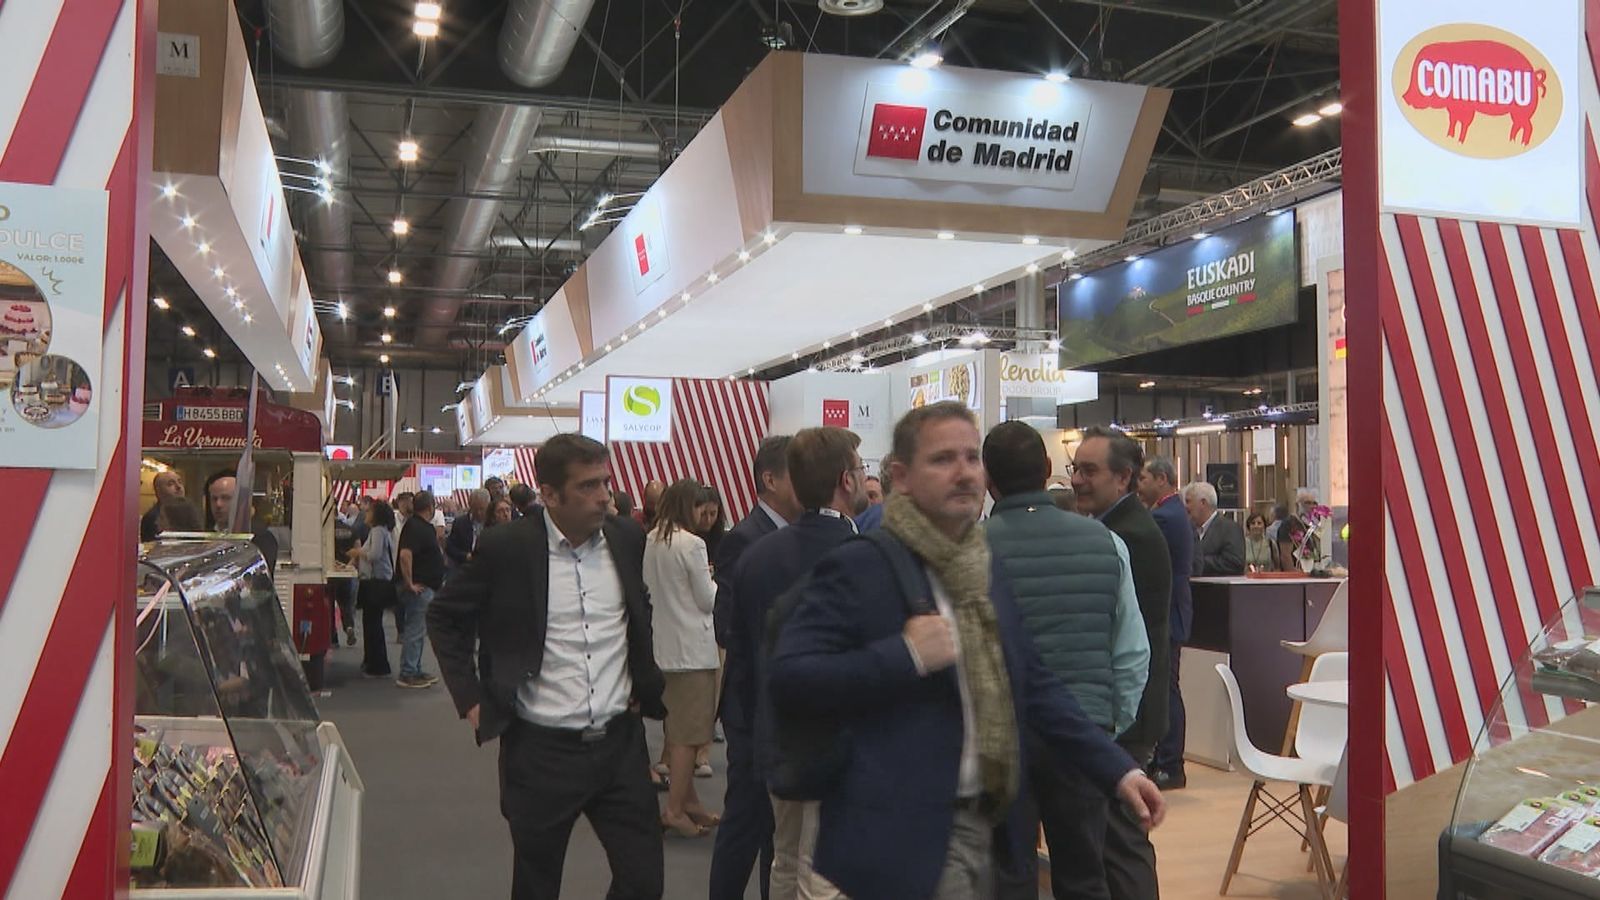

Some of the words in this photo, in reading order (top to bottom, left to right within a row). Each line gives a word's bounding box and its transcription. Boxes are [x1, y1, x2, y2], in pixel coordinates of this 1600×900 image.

[170, 41, 190, 59] M
[1416, 59, 1532, 107] COMABU
[933, 109, 1080, 142] Comunidad
[927, 140, 963, 164] de
[973, 142, 1074, 173] Madrid
[1187, 250, 1255, 290] EUSKADI
[1187, 287, 1216, 306] BASQUE
[1215, 278, 1256, 298] COUNTRY
[173, 371, 191, 388] A
[858, 404, 871, 418] M
[159, 425, 181, 447] La
